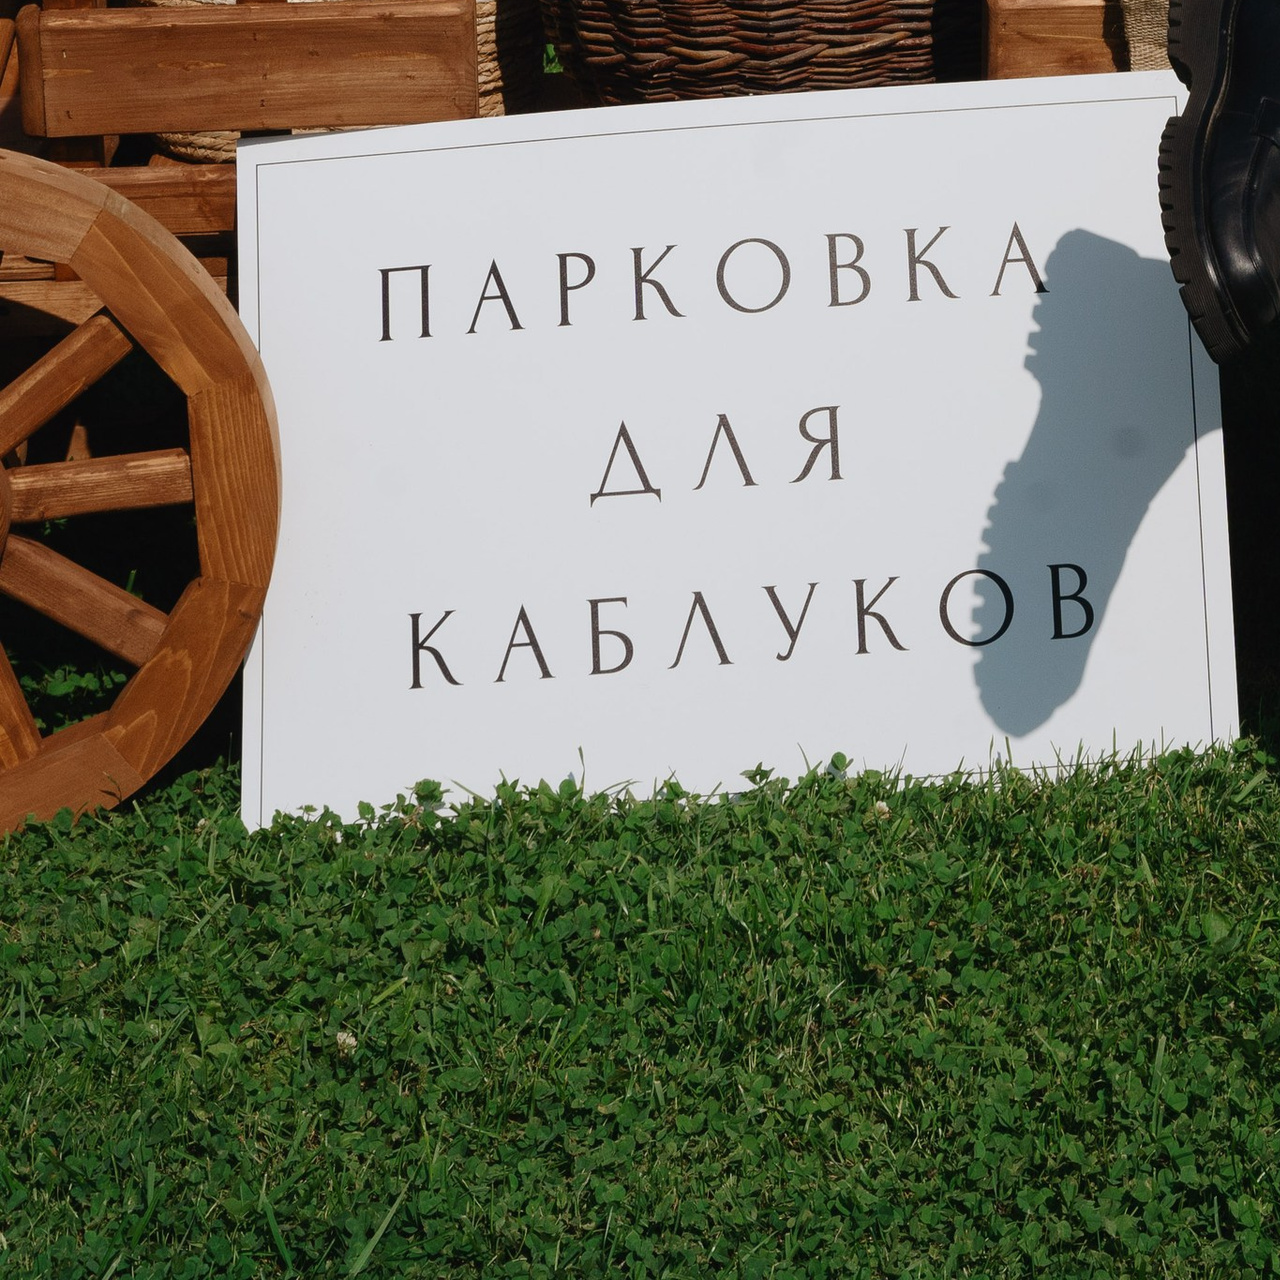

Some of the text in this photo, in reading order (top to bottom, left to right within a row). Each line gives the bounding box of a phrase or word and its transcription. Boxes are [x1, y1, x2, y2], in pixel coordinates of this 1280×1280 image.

[378, 221, 1051, 343] ПАРКОВКА
[589, 405, 844, 508] ДЛЯ
[408, 563, 1095, 690] КАБЛУКОВ
